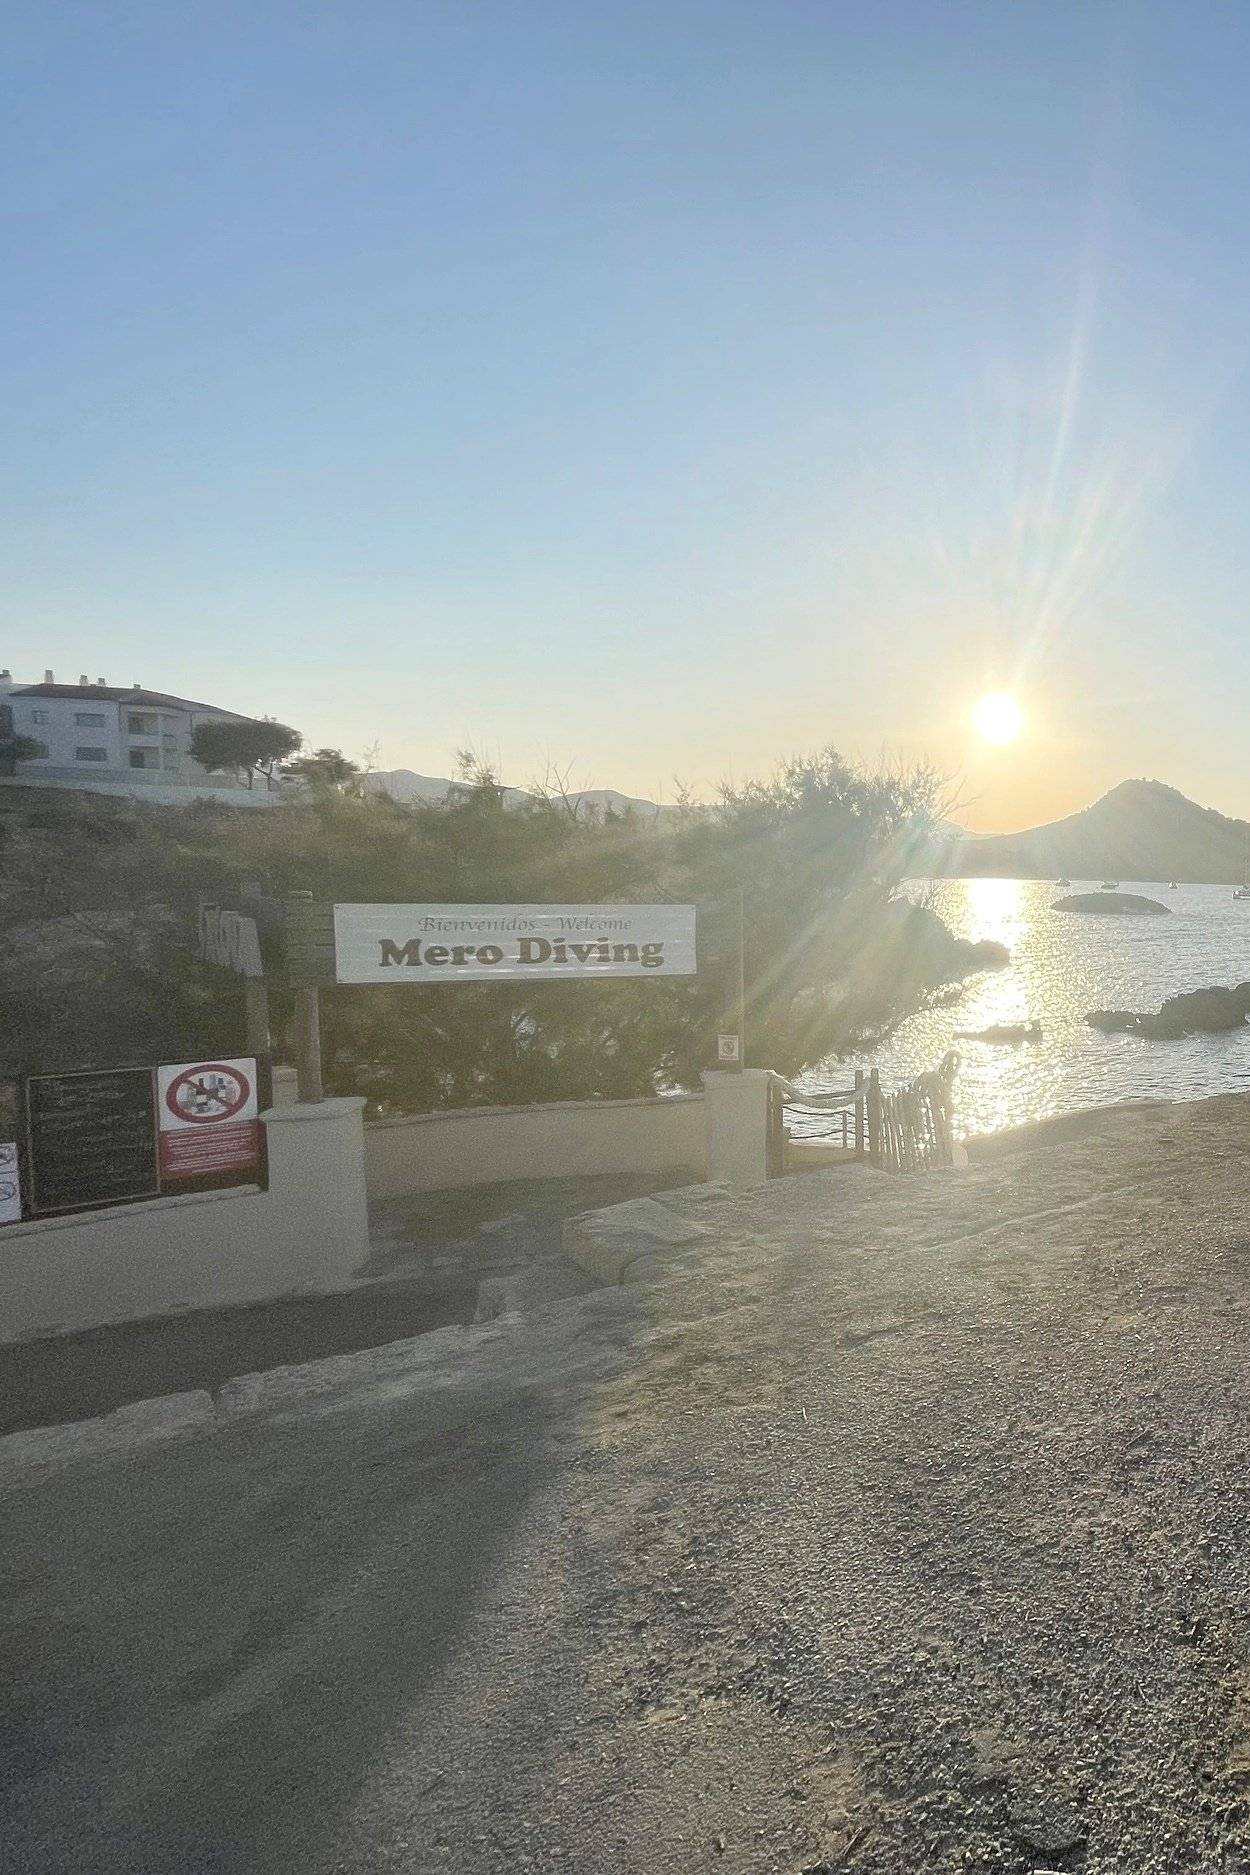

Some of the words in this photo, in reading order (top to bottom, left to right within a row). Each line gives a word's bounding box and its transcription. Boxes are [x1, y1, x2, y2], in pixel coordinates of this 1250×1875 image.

[418, 916, 536, 931] Bienvenidos
[559, 916, 632, 931] Welcome
[378, 937, 504, 967] Mero
[516, 936, 665, 968] Diving
